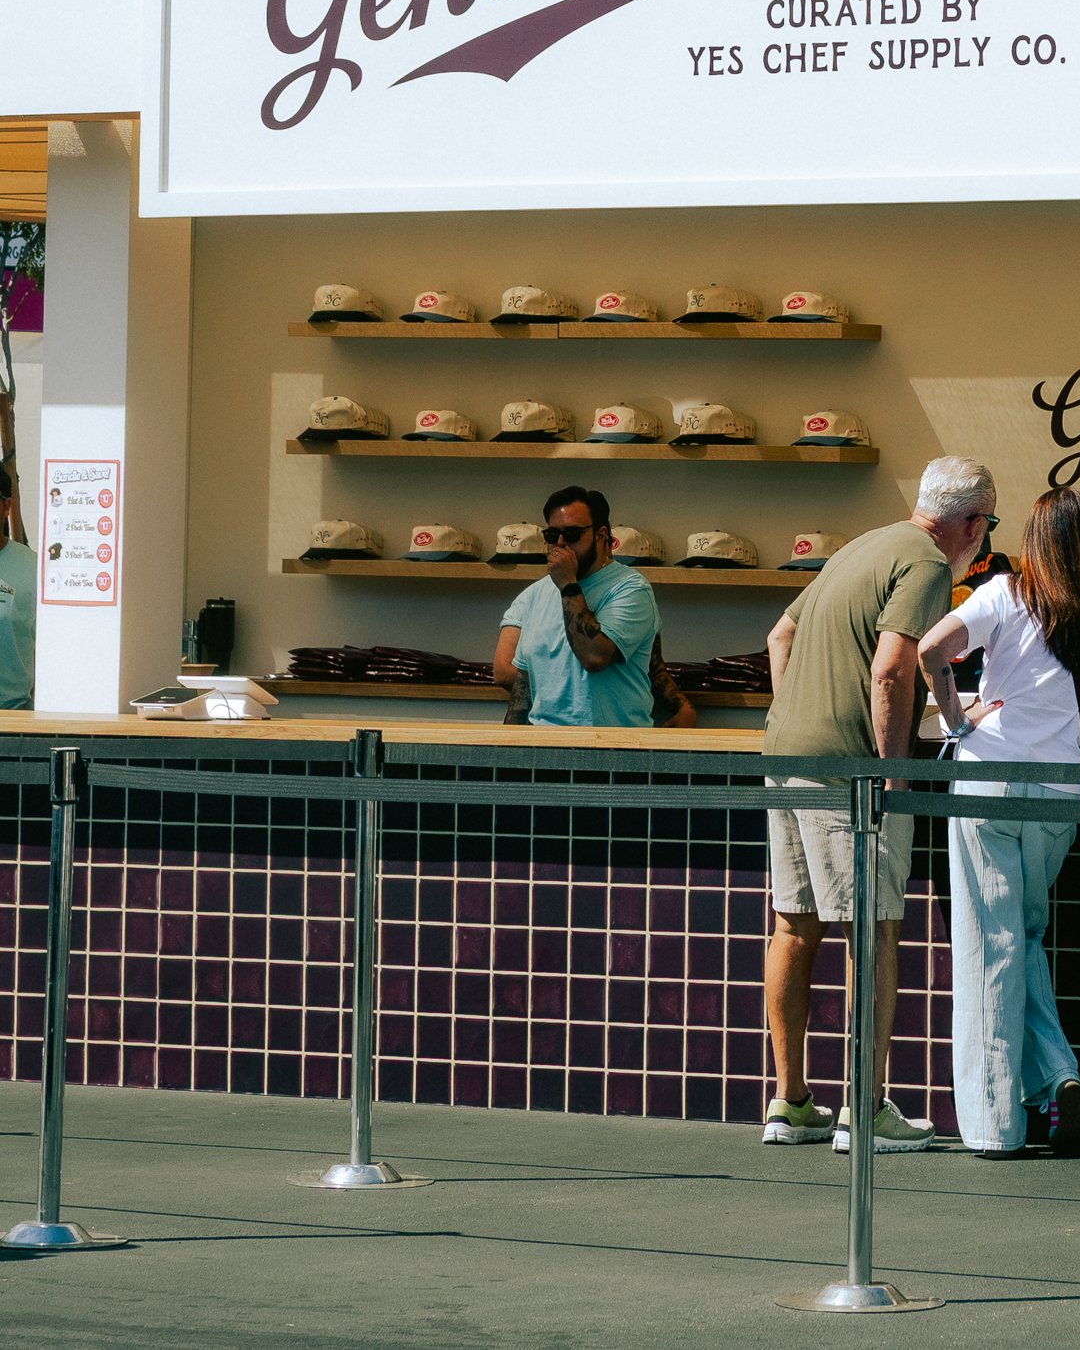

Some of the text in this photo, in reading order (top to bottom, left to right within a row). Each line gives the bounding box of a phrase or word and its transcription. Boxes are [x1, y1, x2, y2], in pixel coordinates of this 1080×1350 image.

[688, 34, 1067, 75] YES CHEF SUPPLY CO.
